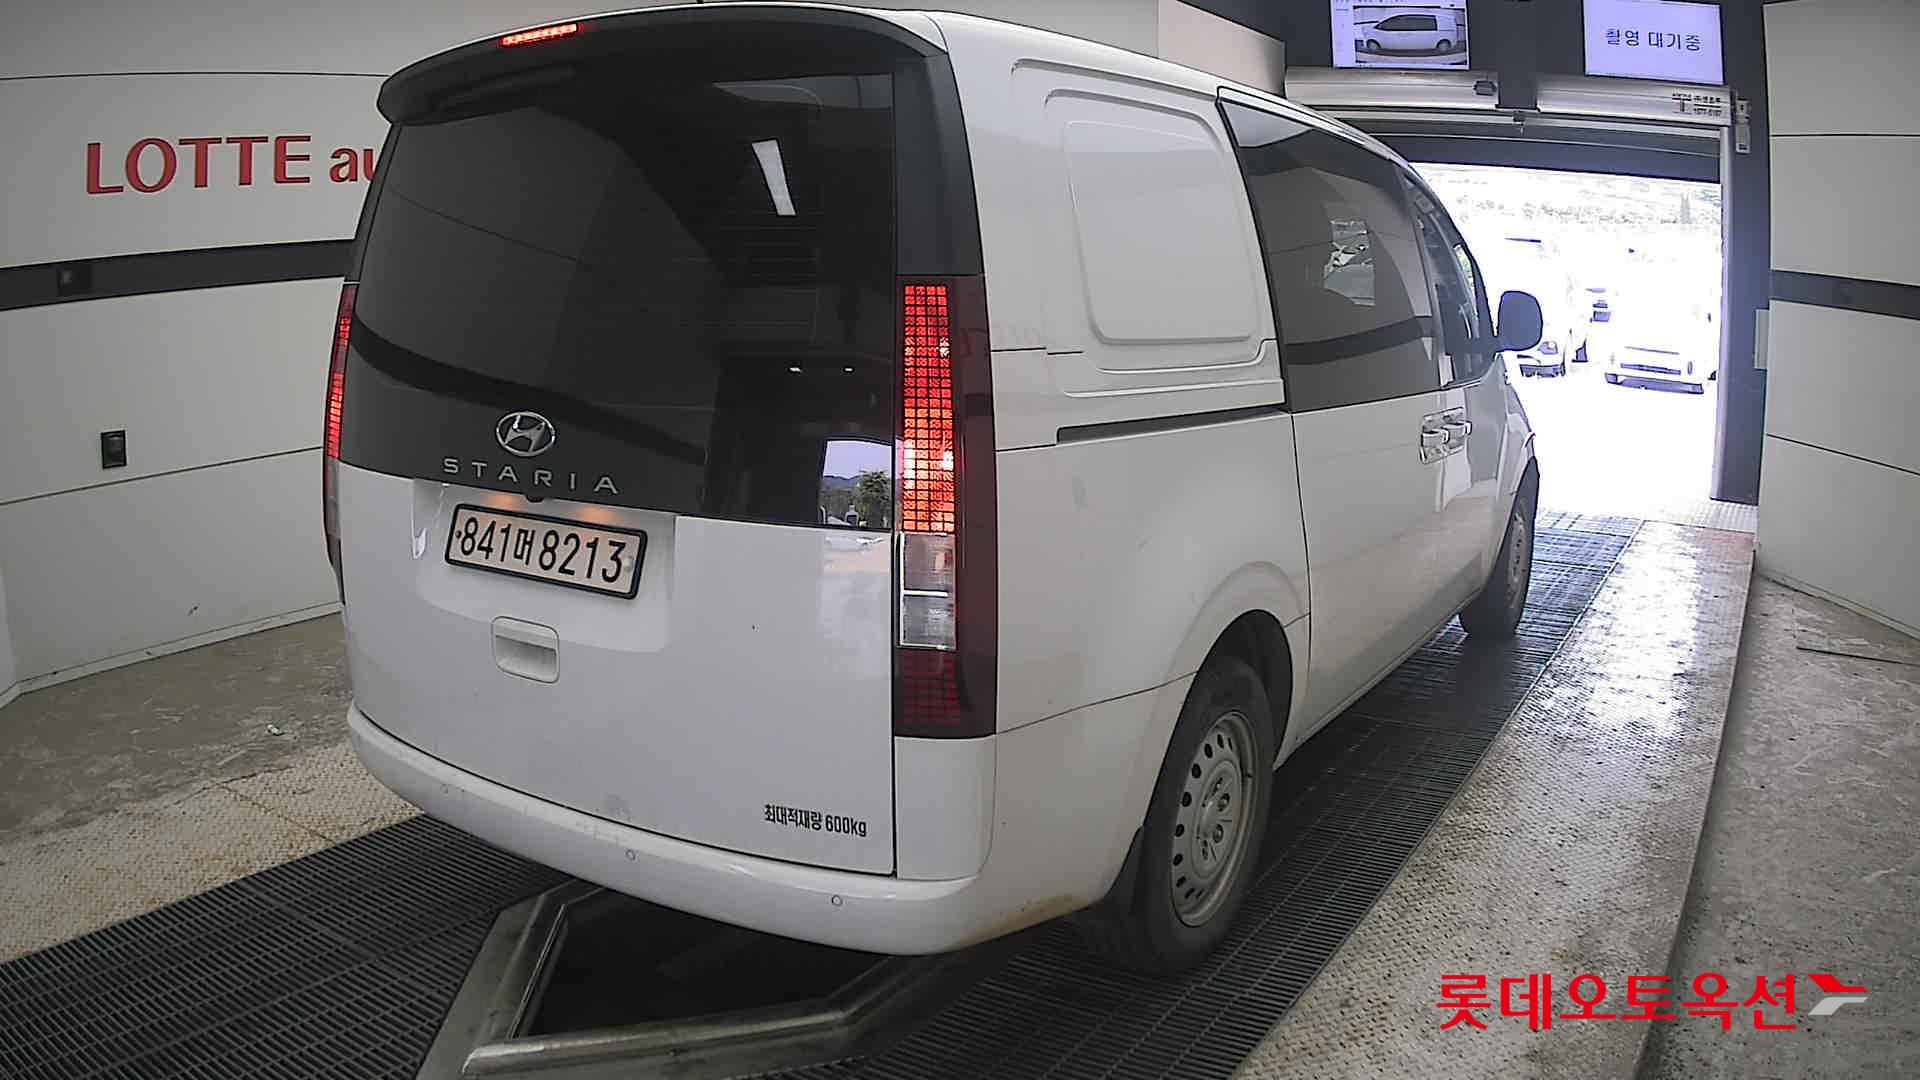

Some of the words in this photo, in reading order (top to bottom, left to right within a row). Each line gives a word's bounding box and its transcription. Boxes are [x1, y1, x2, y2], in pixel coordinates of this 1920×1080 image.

[1648, 31, 1701, 52] 대기중
[86, 135, 312, 194] LOTTE
[443, 457, 619, 494] STARIA
[764, 803, 822, 831] 최대적재량
[825, 814, 867, 838] 600kg
